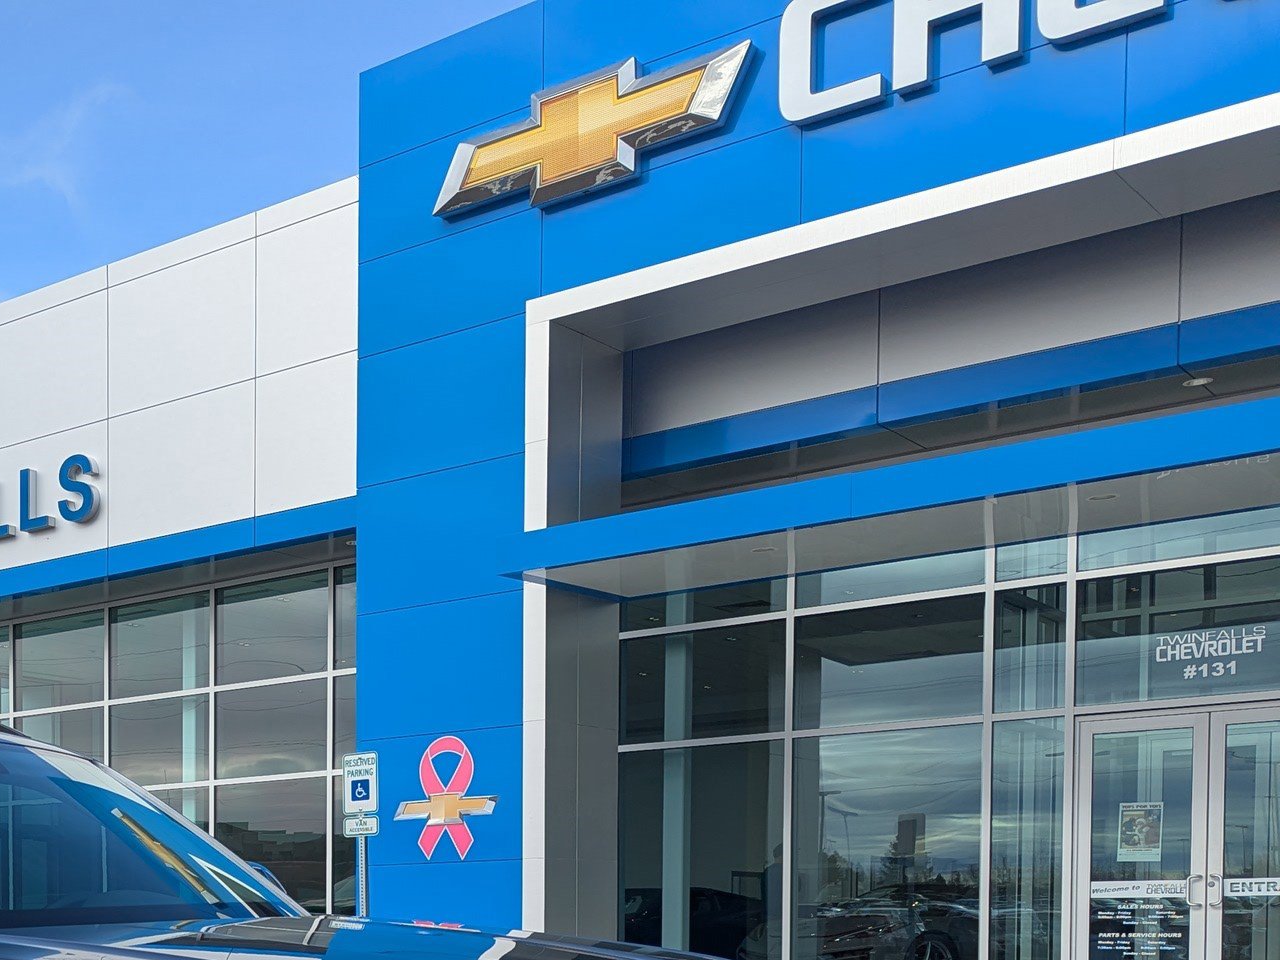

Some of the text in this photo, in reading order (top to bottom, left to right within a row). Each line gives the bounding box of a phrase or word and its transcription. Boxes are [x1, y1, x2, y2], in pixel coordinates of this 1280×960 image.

[1156, 625, 1266, 646] TWINFALLS
[1156, 635, 1266, 663] CHEVROLET
[1183, 660, 1237, 679] #131
[345, 757, 375, 768] RESERVED
[347, 768, 374, 778] PARKING
[1229, 881, 1280, 893] ENTR
